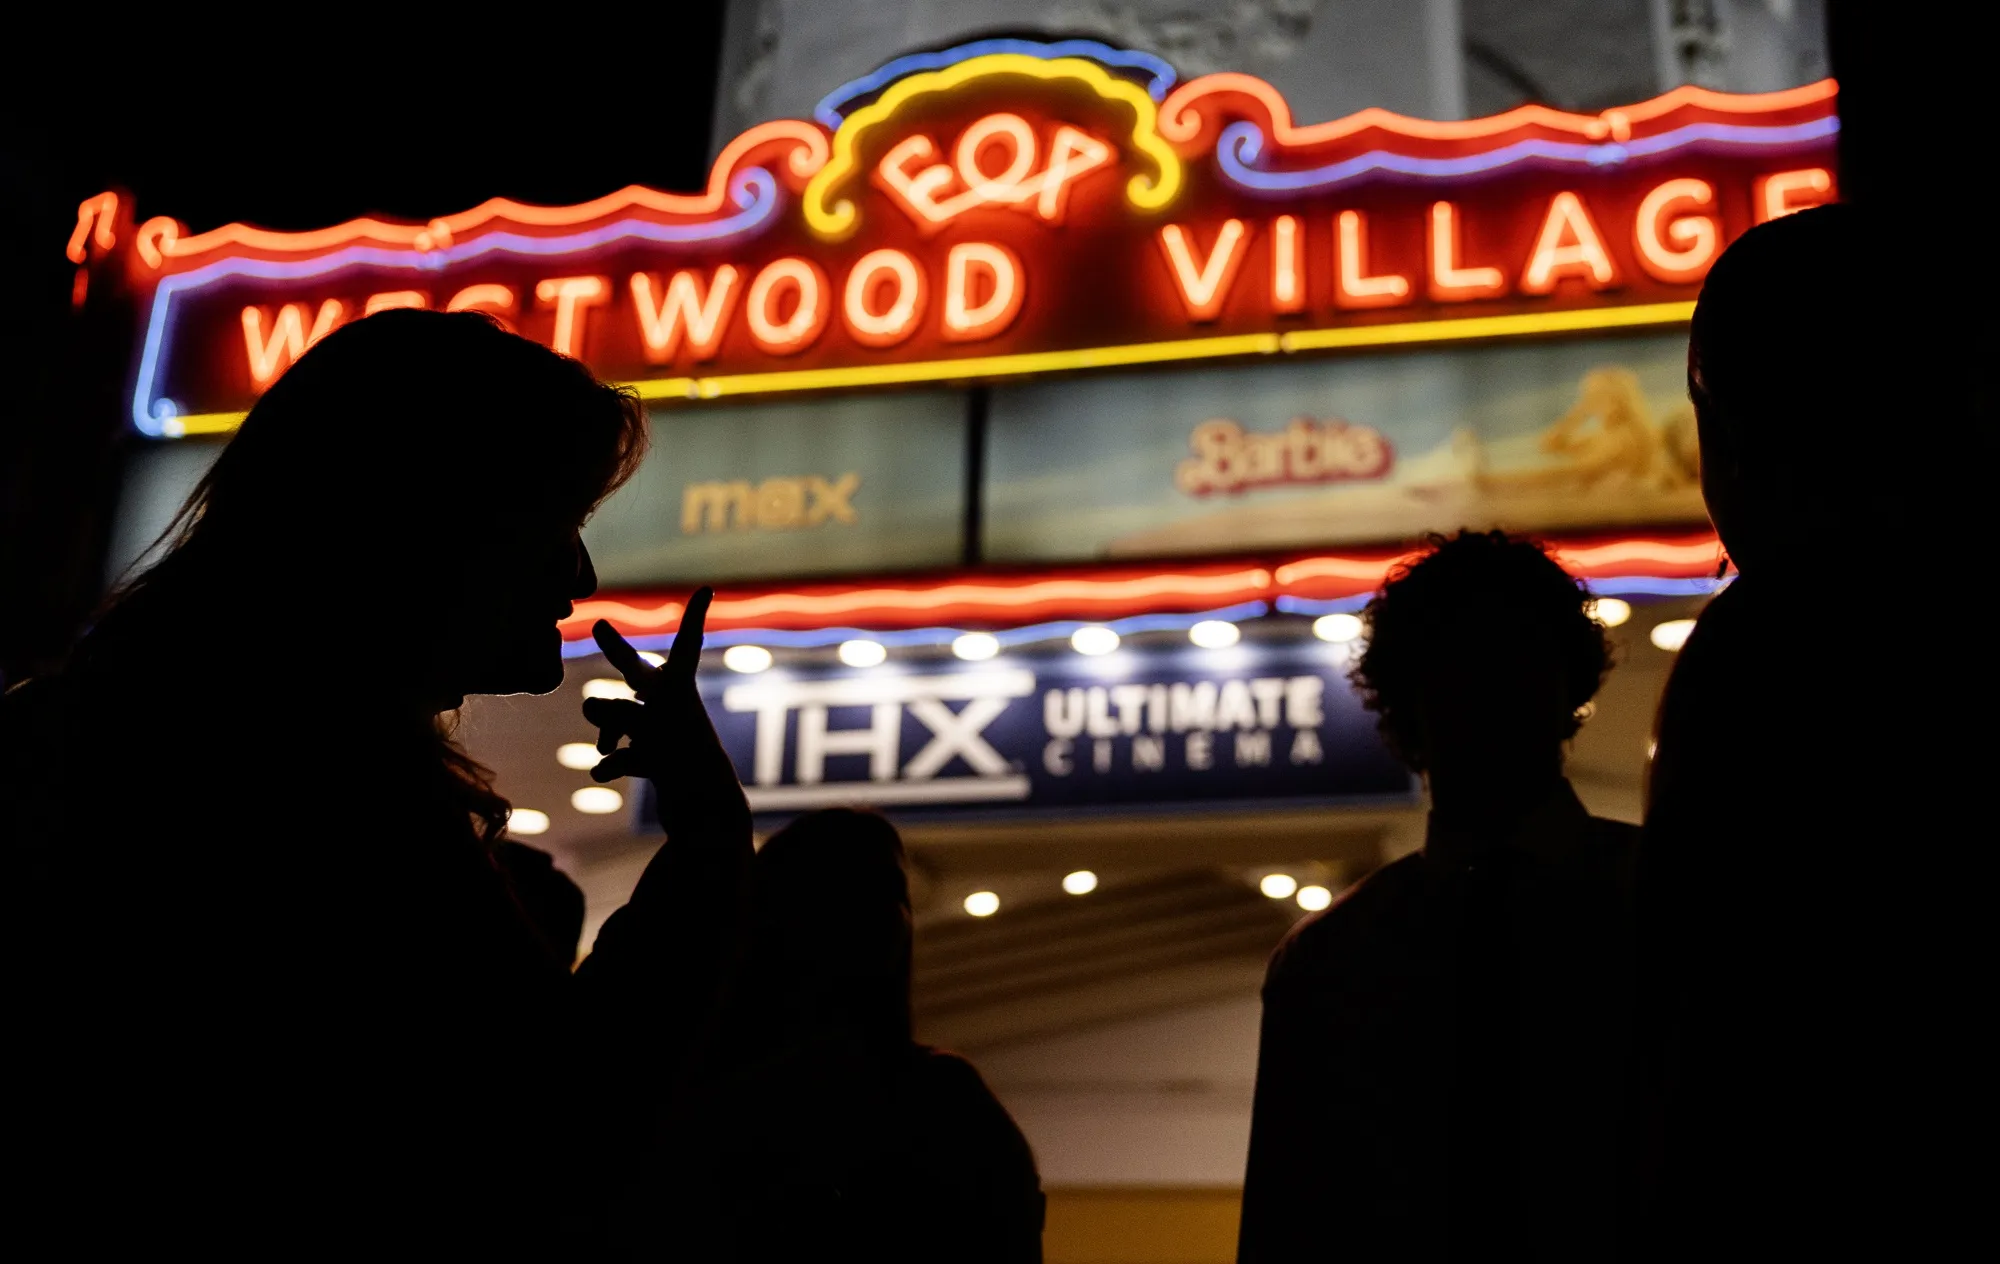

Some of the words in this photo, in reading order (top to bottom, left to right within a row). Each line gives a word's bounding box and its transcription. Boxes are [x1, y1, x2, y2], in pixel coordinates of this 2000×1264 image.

[876, 112, 1114, 226] FOX
[238, 241, 1023, 388] WTWOOD
[1174, 415, 1394, 498] Barbie
[681, 473, 859, 533] max
[724, 670, 1036, 786] THX
[1043, 675, 1324, 738] ULTIMATE
[1043, 730, 1324, 776] CINEMA
